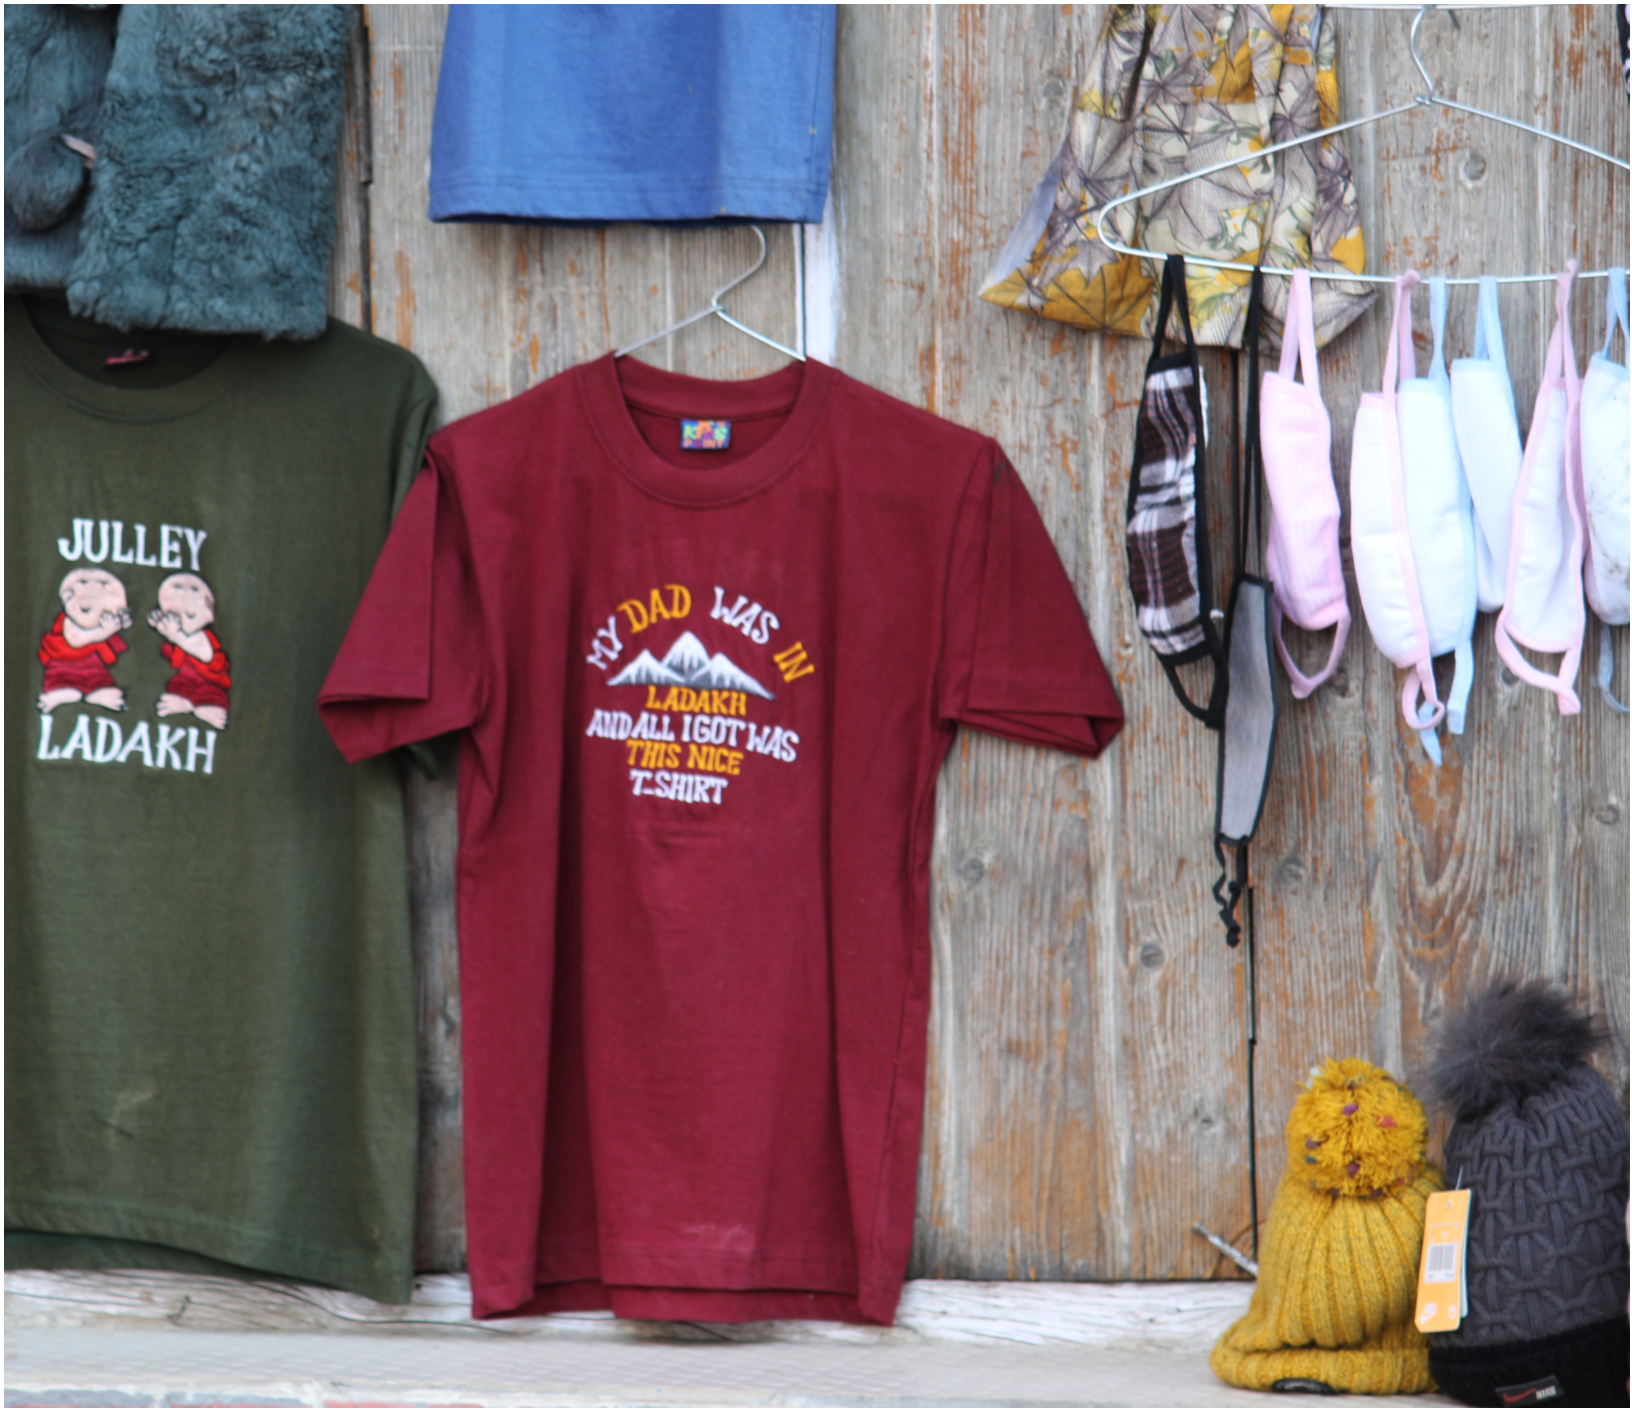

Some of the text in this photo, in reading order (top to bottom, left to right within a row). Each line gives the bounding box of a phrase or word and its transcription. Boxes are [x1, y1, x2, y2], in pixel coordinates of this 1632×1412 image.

[57, 517, 207, 571] JULLEY
[586, 583, 816, 684] MY DAD WAS IN
[645, 684, 747, 716] LADAKH
[37, 714, 217, 774] LADAKH
[585, 708, 800, 763] AND ALL I GOT WAS
[626, 737, 744, 776] THIS NICE
